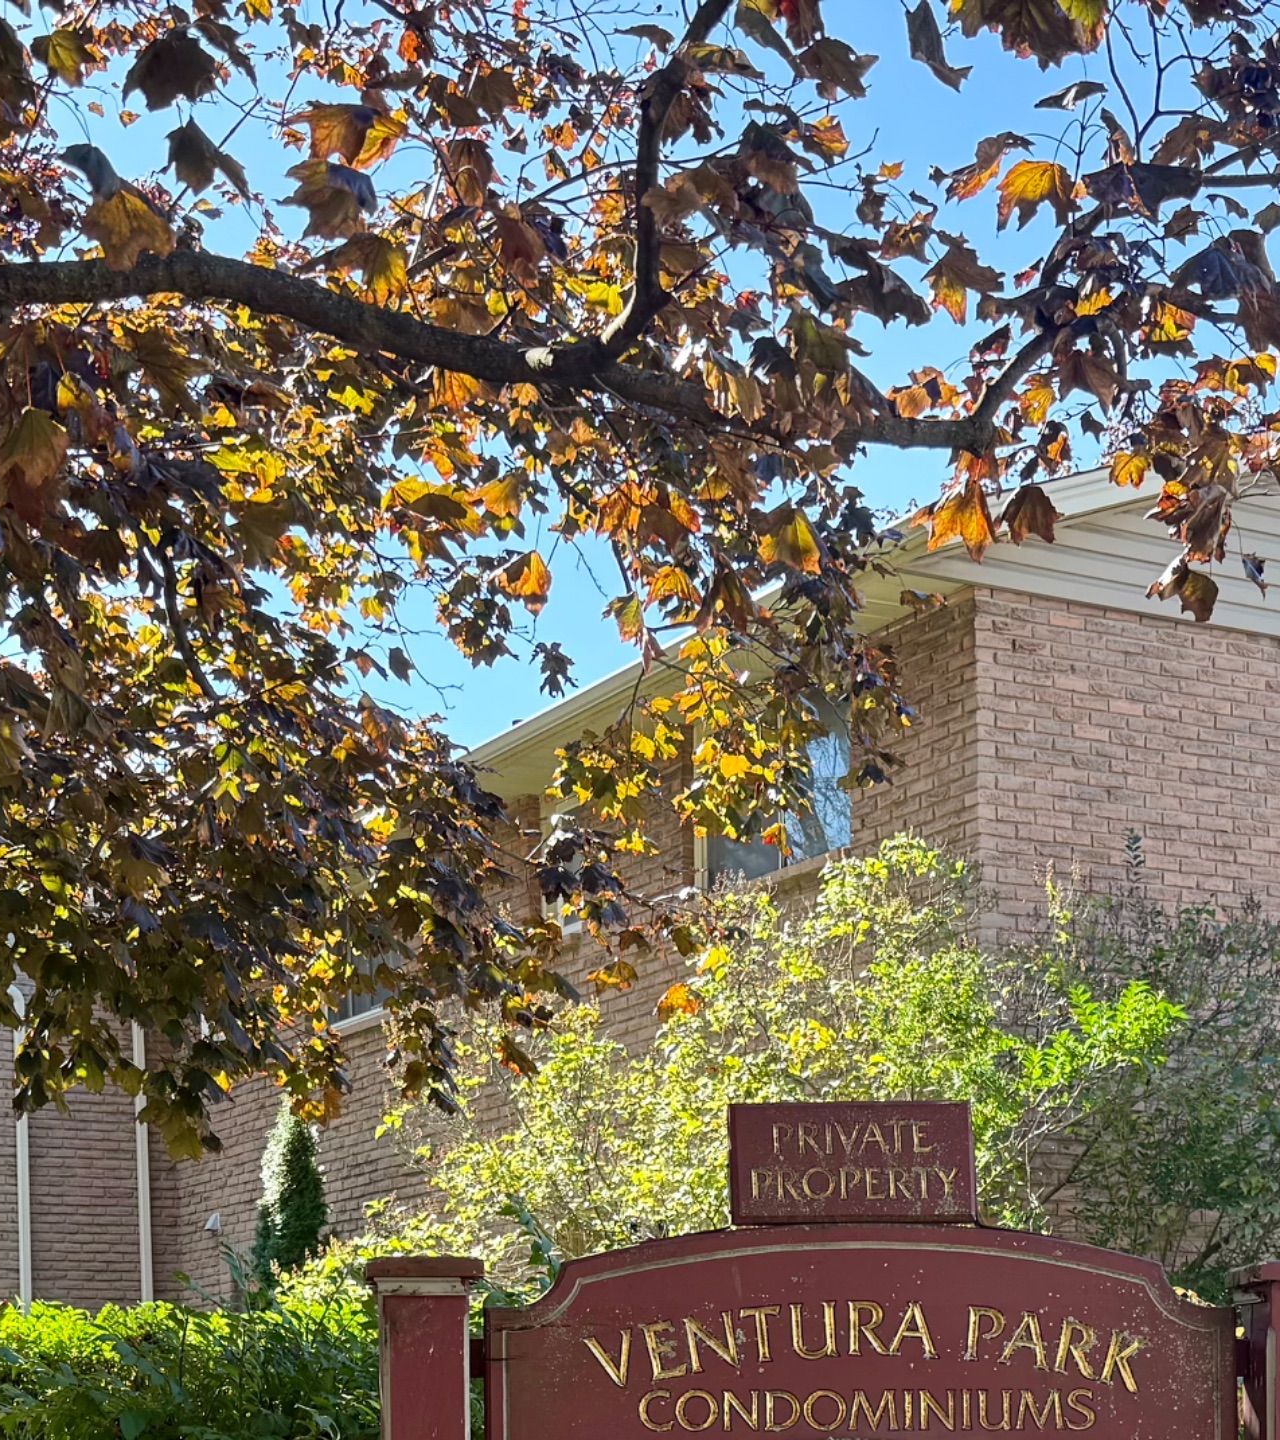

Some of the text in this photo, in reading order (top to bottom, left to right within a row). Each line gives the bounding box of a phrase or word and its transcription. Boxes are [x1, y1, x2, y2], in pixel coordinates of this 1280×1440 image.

[772, 1120, 936, 1155] PRIVATE
[750, 1167, 959, 1200] PROPERTY
[582, 1300, 1148, 1394] VENTURA PARK
[638, 1388, 1097, 1433] CONDOMINIUMS
